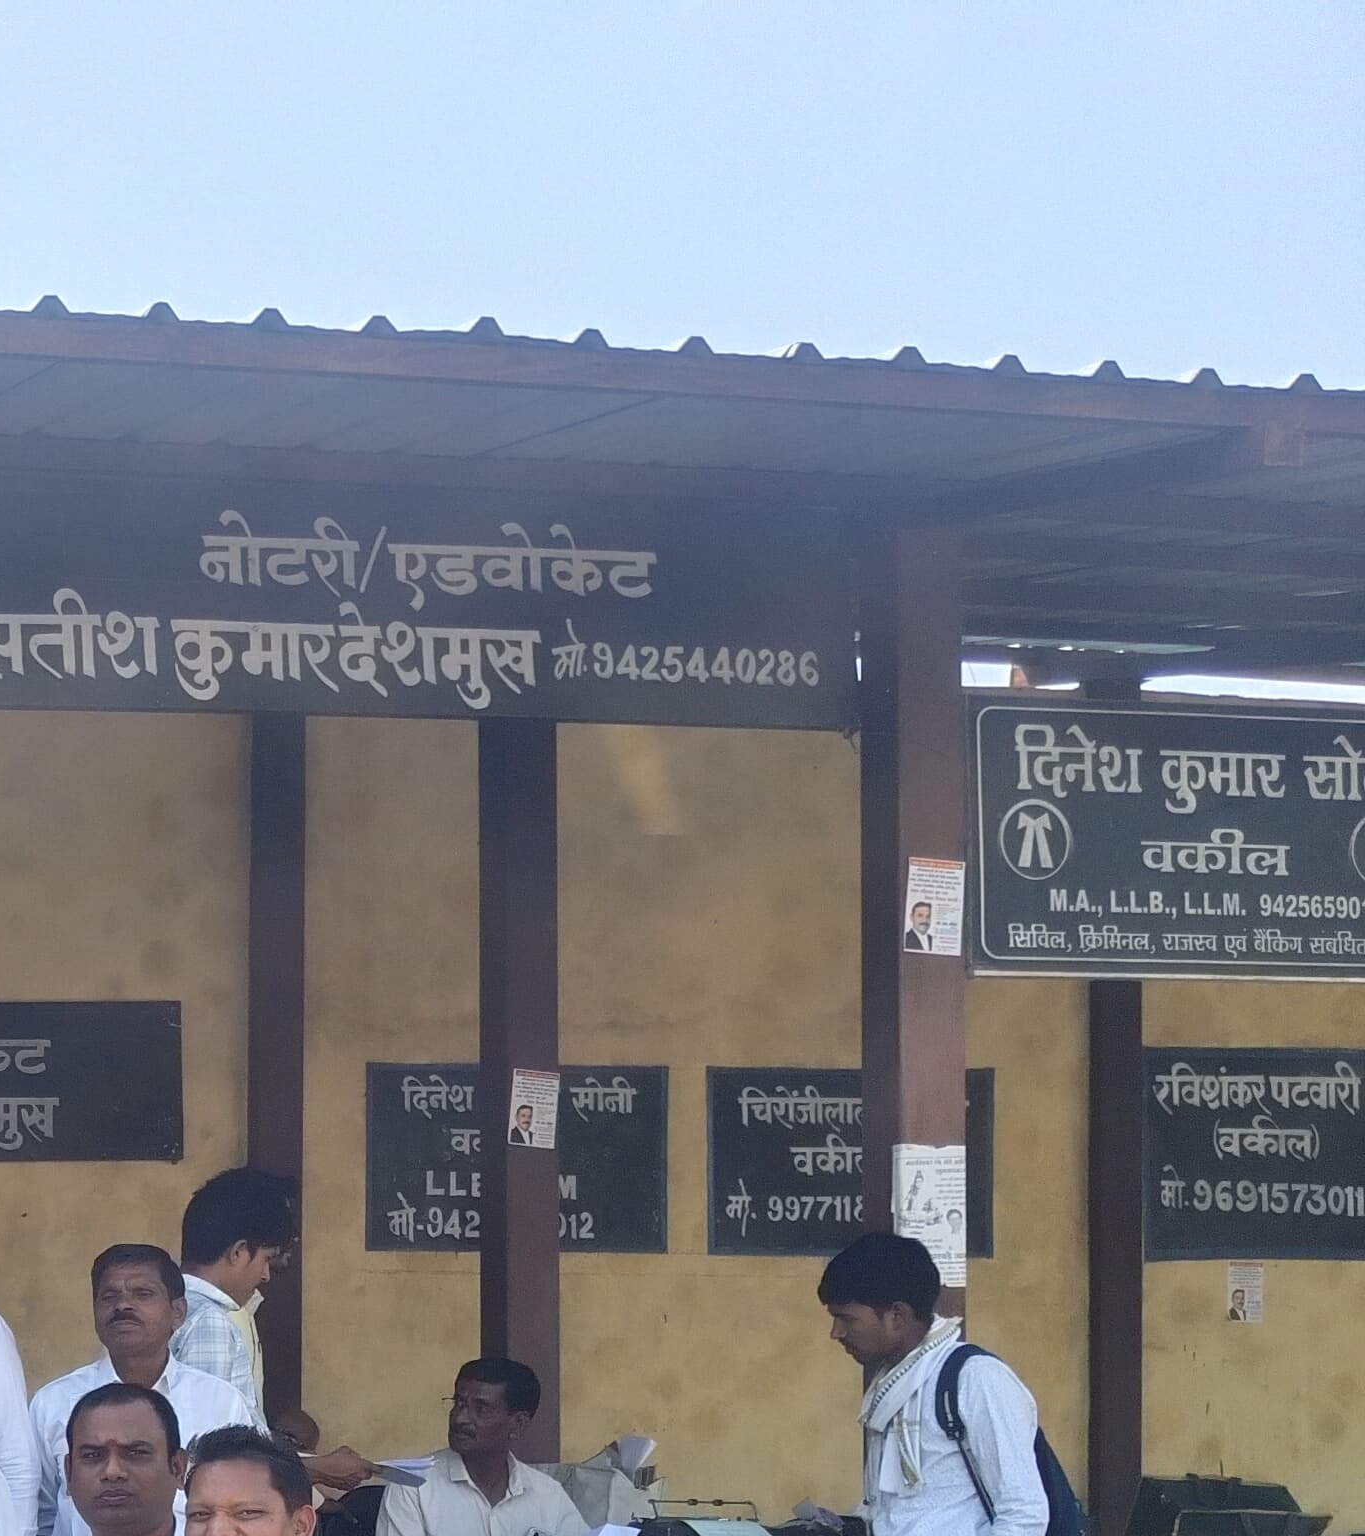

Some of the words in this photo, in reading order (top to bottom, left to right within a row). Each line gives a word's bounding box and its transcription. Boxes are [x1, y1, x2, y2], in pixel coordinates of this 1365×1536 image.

[170, 618, 339, 702] कुमार
[338, 601, 541, 710] देशमुख
[592, 640, 820, 688] 9425440286
[1014, 723, 1142, 798] दिनेश
[1159, 749, 1285, 814] कुमार
[1303, 735, 1365, 800] सो
[1140, 828, 1290, 877] वकील
[1049, 889, 1102, 918] M.A.,
[1111, 891, 1176, 919] L.L.B.,
[1185, 892, 1246, 916] L.L.M.
[1008, 923, 1072, 953] सिविल,
[1078, 924, 1155, 954] क्रिमिनल,
[1162, 933, 1218, 952] राजस्व
[1224, 928, 1247, 958] एवं
[401, 1074, 474, 1119] दिनेश
[570, 1076, 637, 1122] सोनी
[738, 1085, 863, 1133] चिरोंजीला
[1153, 1062, 1272, 1115] रविशंकर
[1270, 1061, 1361, 1115] पटवारी
[790, 1133, 863, 1176] वकी
[1213, 1115, 1319, 1161] (वकील)
